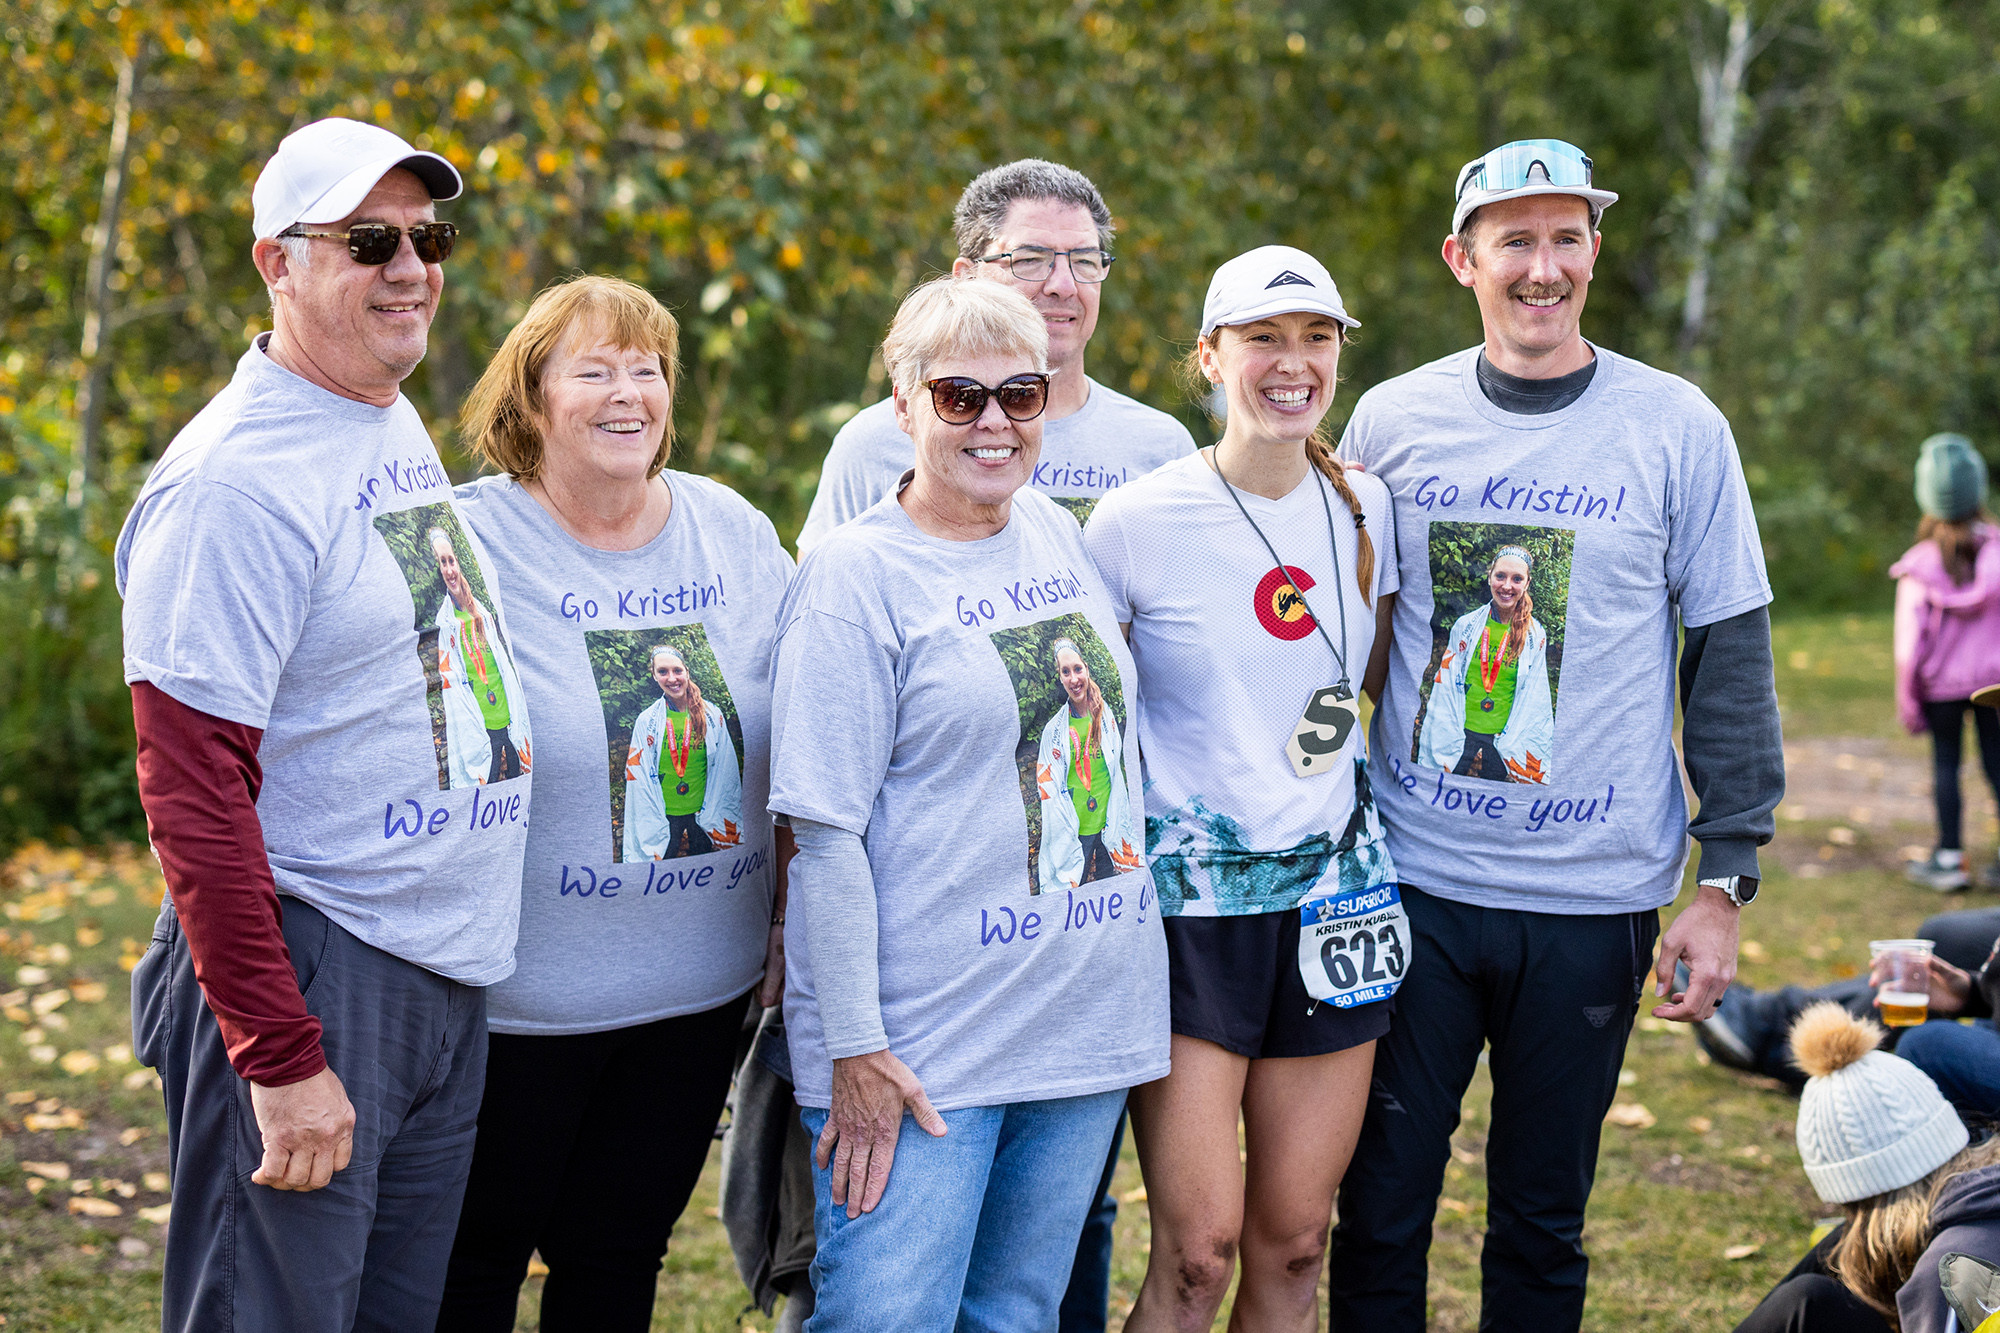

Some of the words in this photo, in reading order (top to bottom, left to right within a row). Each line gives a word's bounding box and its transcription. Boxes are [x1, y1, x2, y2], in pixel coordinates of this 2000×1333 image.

[1414, 475, 1460, 512] Go
[1479, 475, 1626, 522] Kristin!
[560, 592, 599, 623] Go
[617, 573, 727, 619] Kristin!
[956, 594, 996, 628] Go
[1003, 567, 1089, 613] Kristin!
[383, 798, 450, 840] We
[469, 787, 521, 832] love
[1431, 772, 1508, 820] love
[1524, 783, 1615, 833] you!
[559, 864, 623, 898] We
[643, 862, 714, 896] love
[1336, 886, 1392, 916] SUPERIOR
[980, 905, 1042, 947] We
[1063, 889, 1124, 933] love
[1315, 919, 1363, 937] KRISTIN
[1320, 924, 1405, 990] 623
[1334, 994, 1353, 1008] 50
[1353, 986, 1386, 1003] MILE
